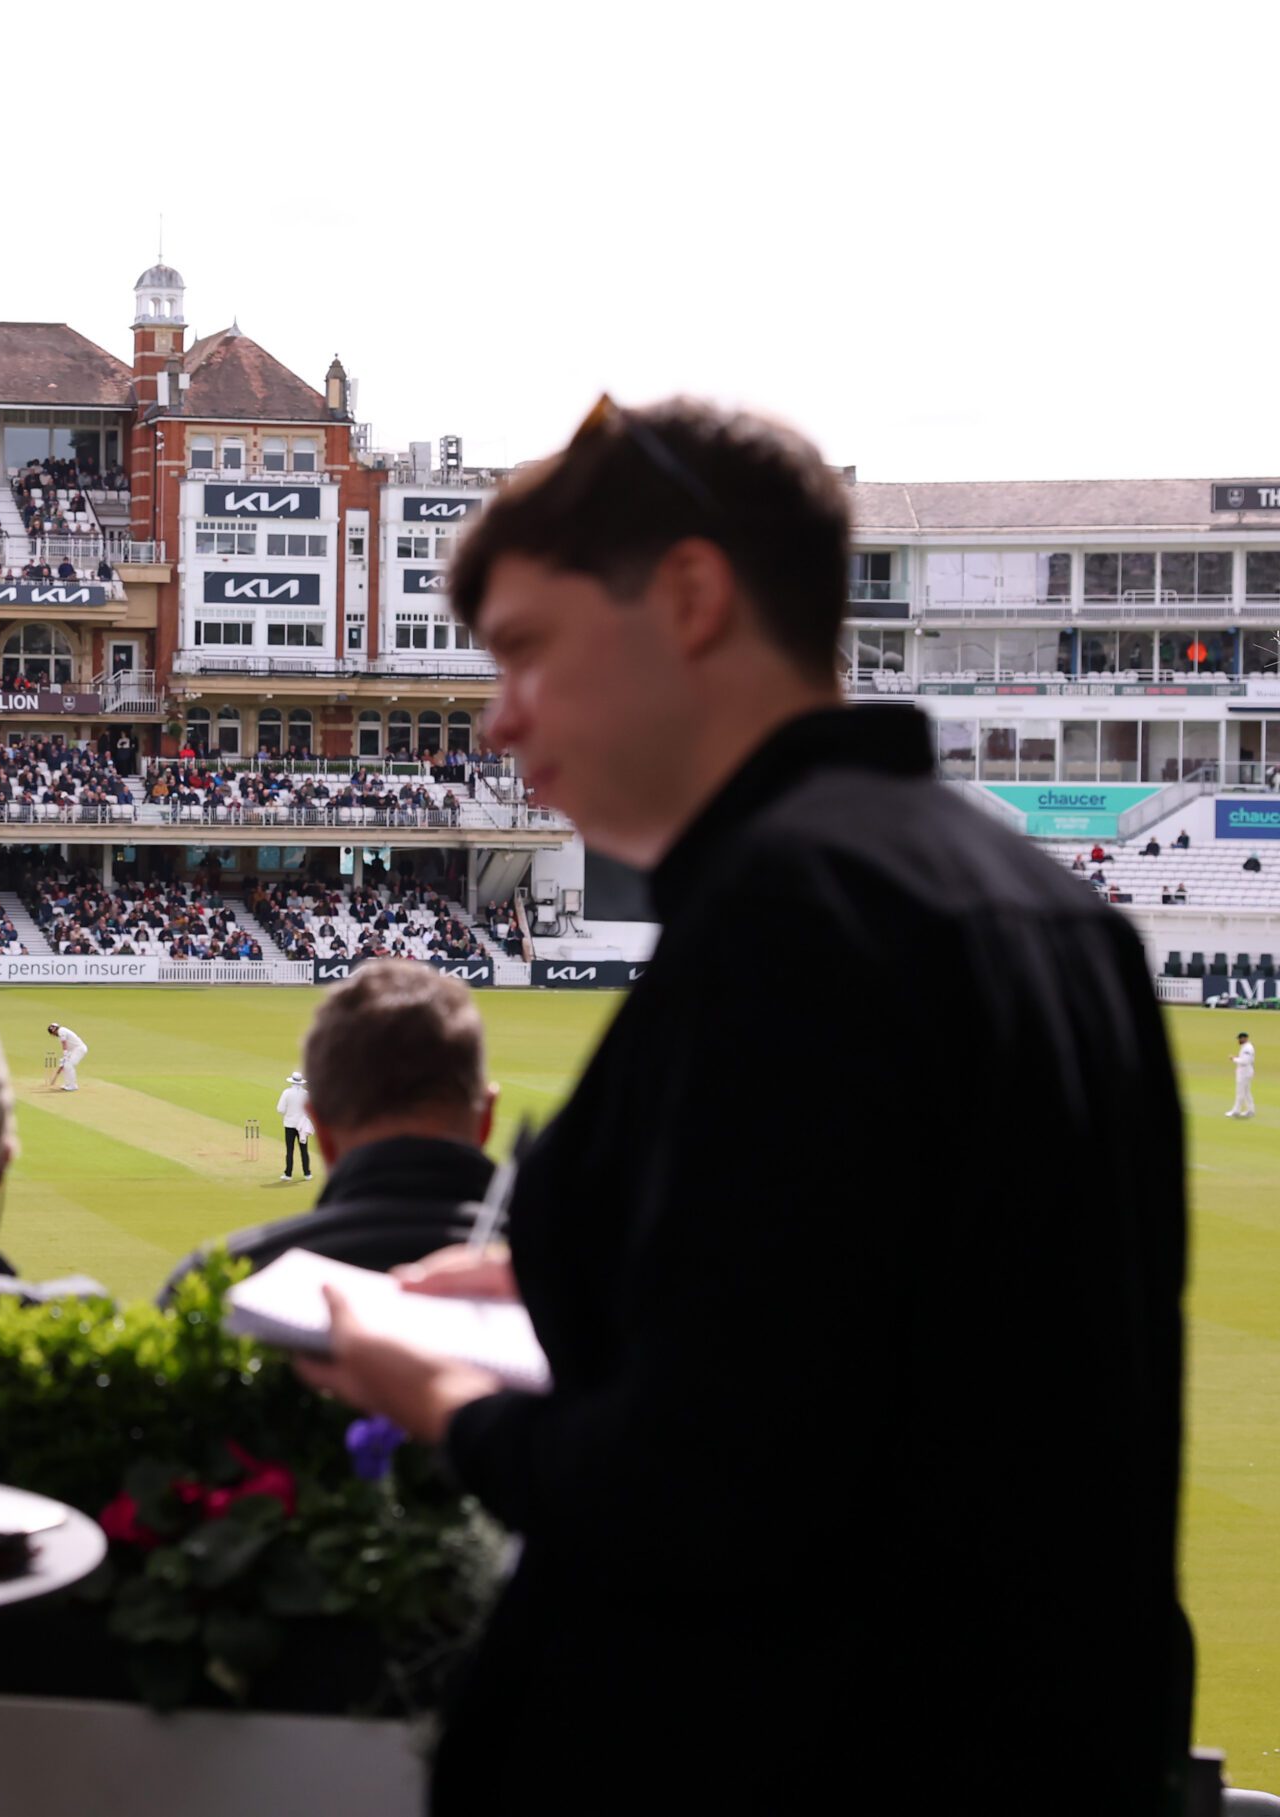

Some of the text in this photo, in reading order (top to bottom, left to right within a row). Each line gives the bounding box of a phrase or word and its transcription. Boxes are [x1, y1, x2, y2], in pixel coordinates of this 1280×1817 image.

[225, 491, 300, 512] KIA
[225, 578, 300, 599] KIA
[1038, 790, 1106, 806] chaucer
[8, 961, 77, 978] pension
[84, 962, 147, 976] insurer
[547, 966, 596, 981] KIA
